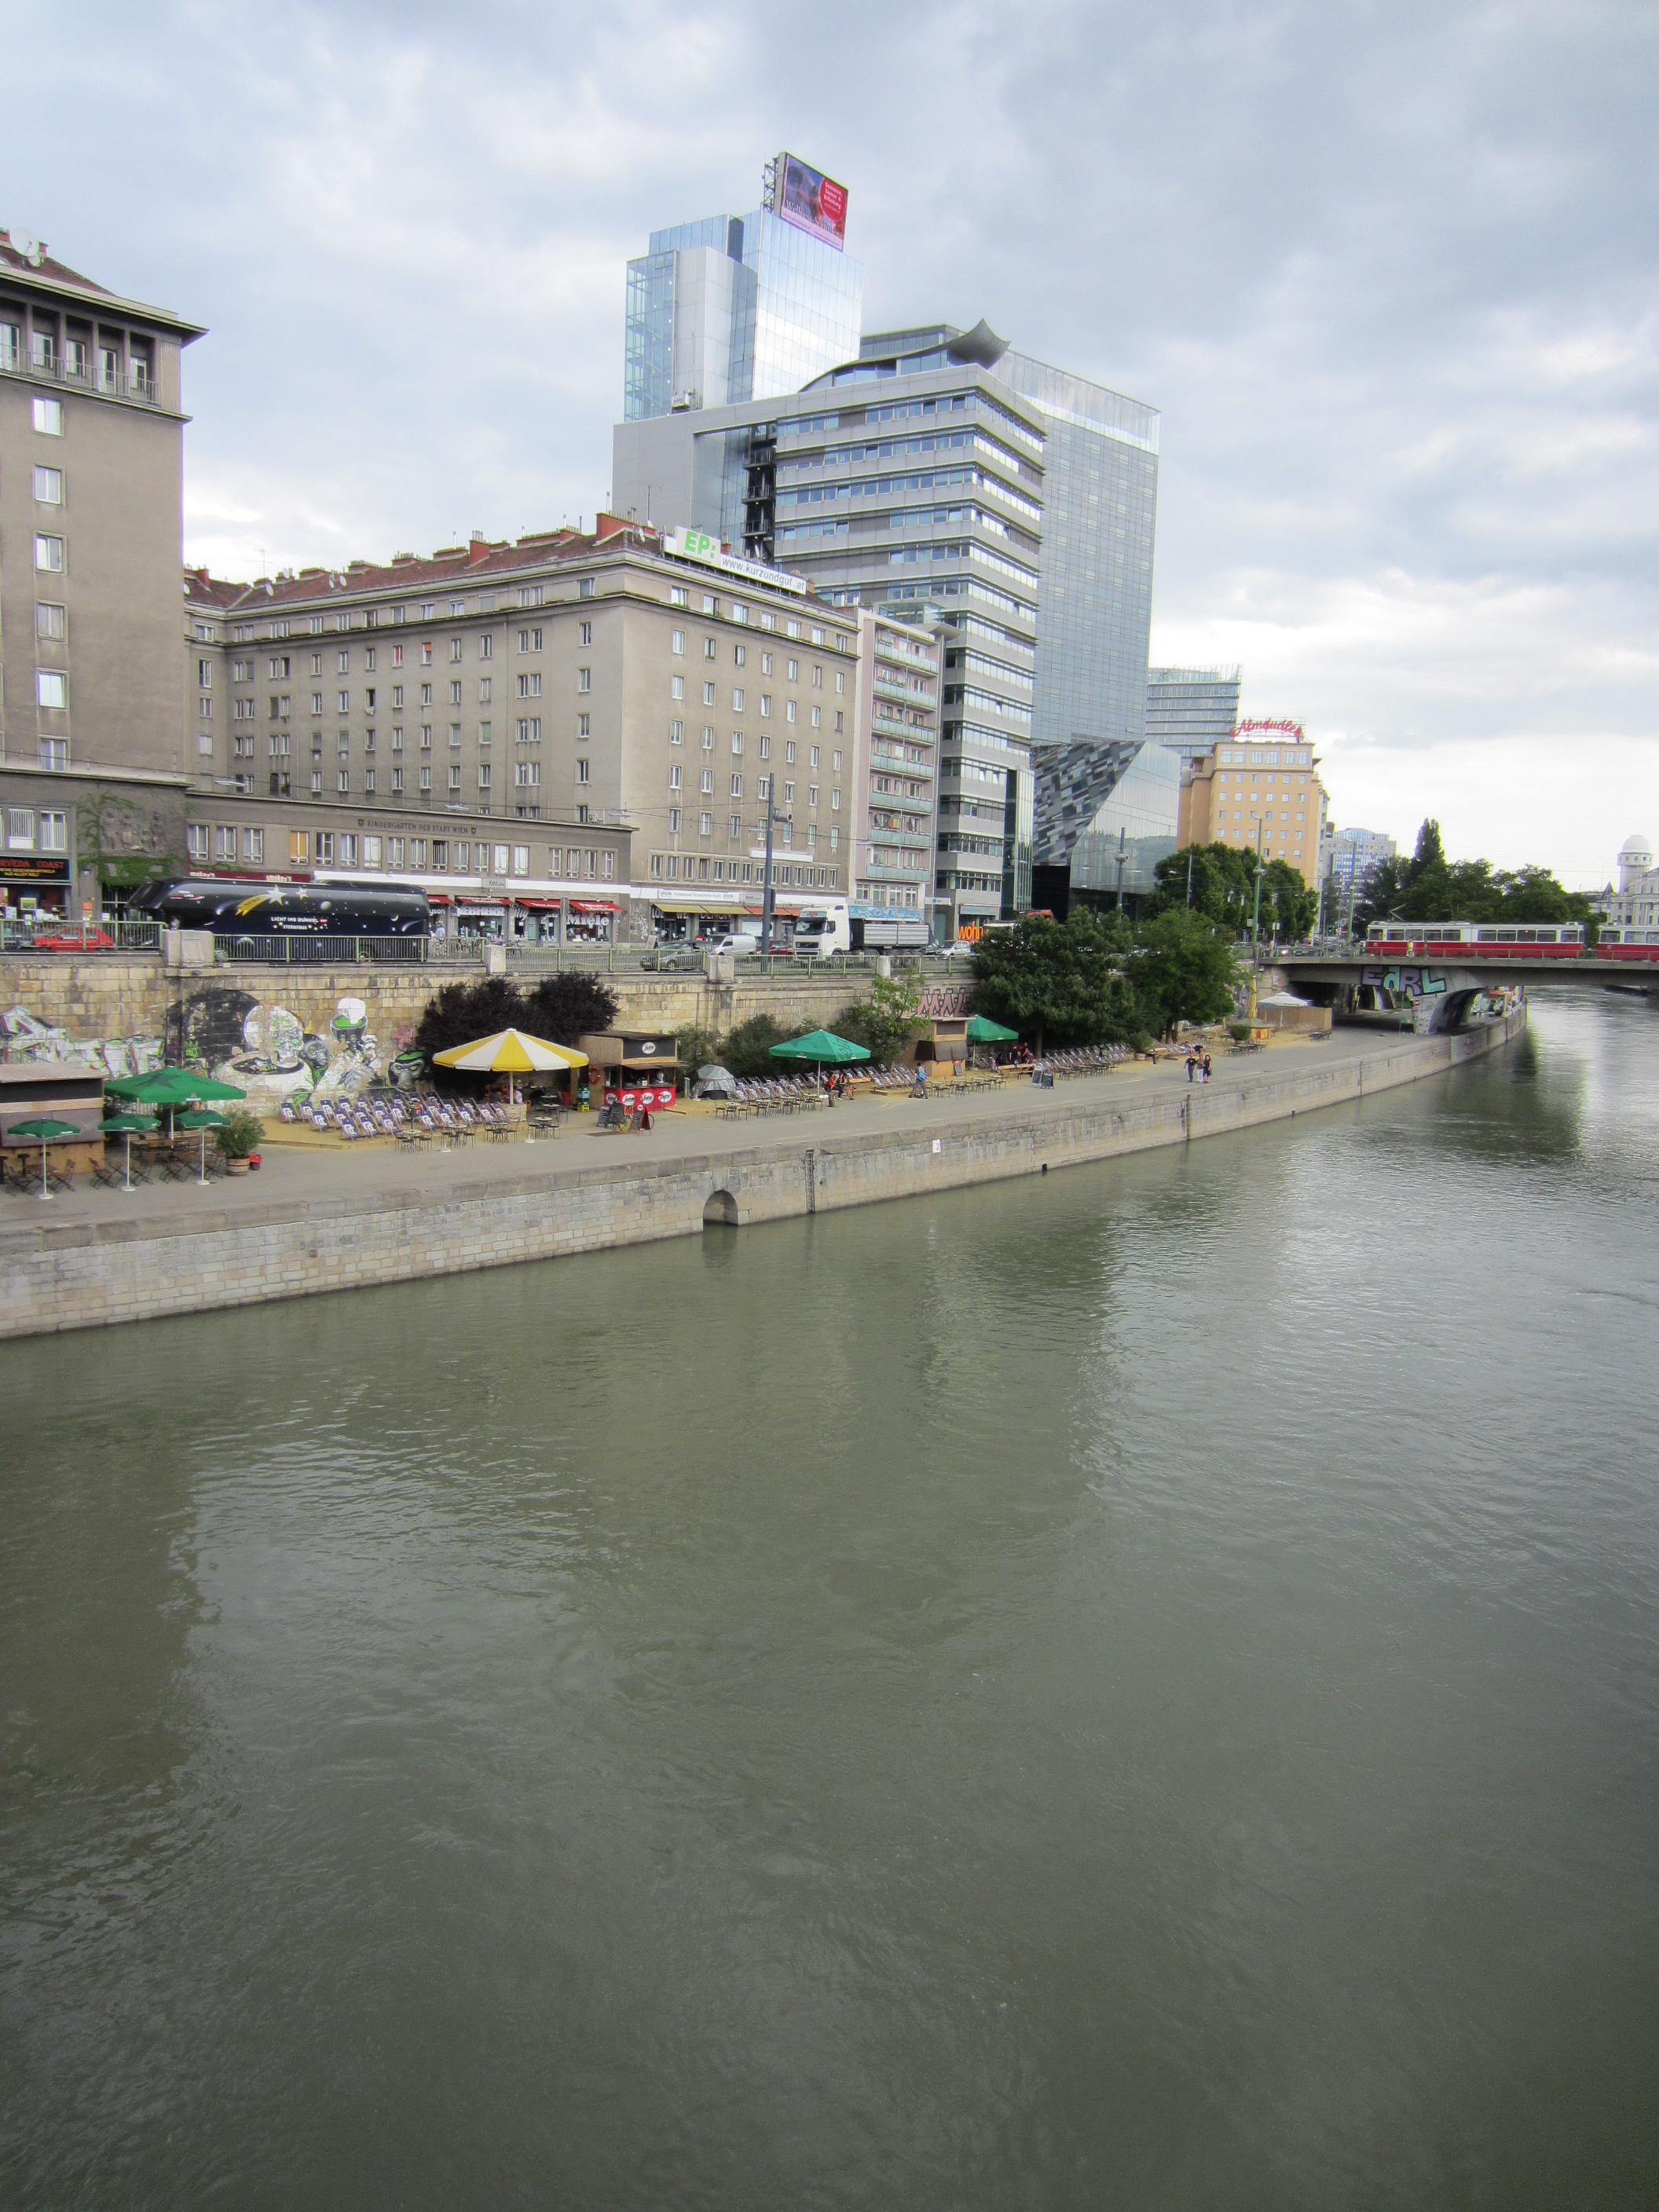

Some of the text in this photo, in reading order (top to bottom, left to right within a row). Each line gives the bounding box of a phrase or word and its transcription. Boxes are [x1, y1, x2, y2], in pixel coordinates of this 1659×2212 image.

[722, 557, 804, 591] www.kurzundgut.at
[367, 820, 417, 830] KINDERGARTEN
[566, 914, 610, 926] Miele
